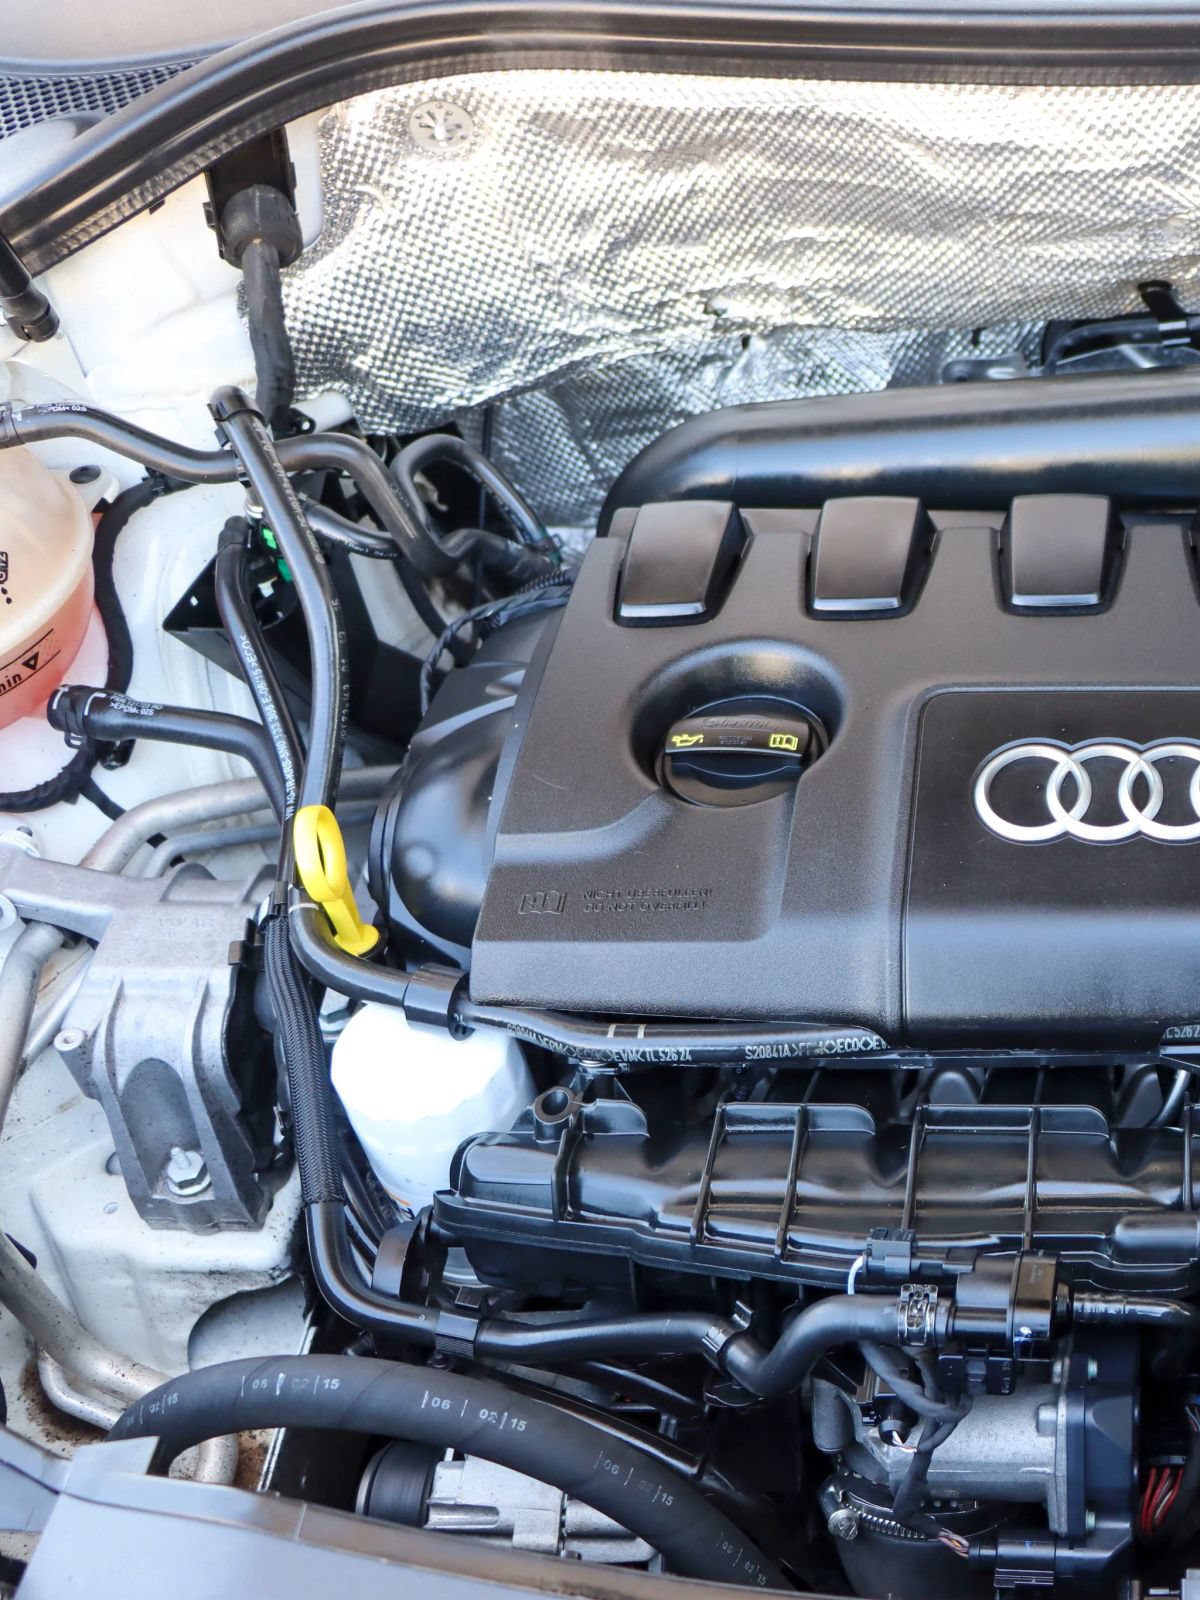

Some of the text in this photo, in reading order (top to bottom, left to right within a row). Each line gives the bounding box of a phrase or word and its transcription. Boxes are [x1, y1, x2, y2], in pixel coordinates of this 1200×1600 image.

[323, 1379, 340, 1389] 15
[431, 1397, 451, 1410] 06
[511, 1418, 527, 1431] 15
[603, 1459, 620, 1474] 06
[661, 1492, 674, 1506] 15
